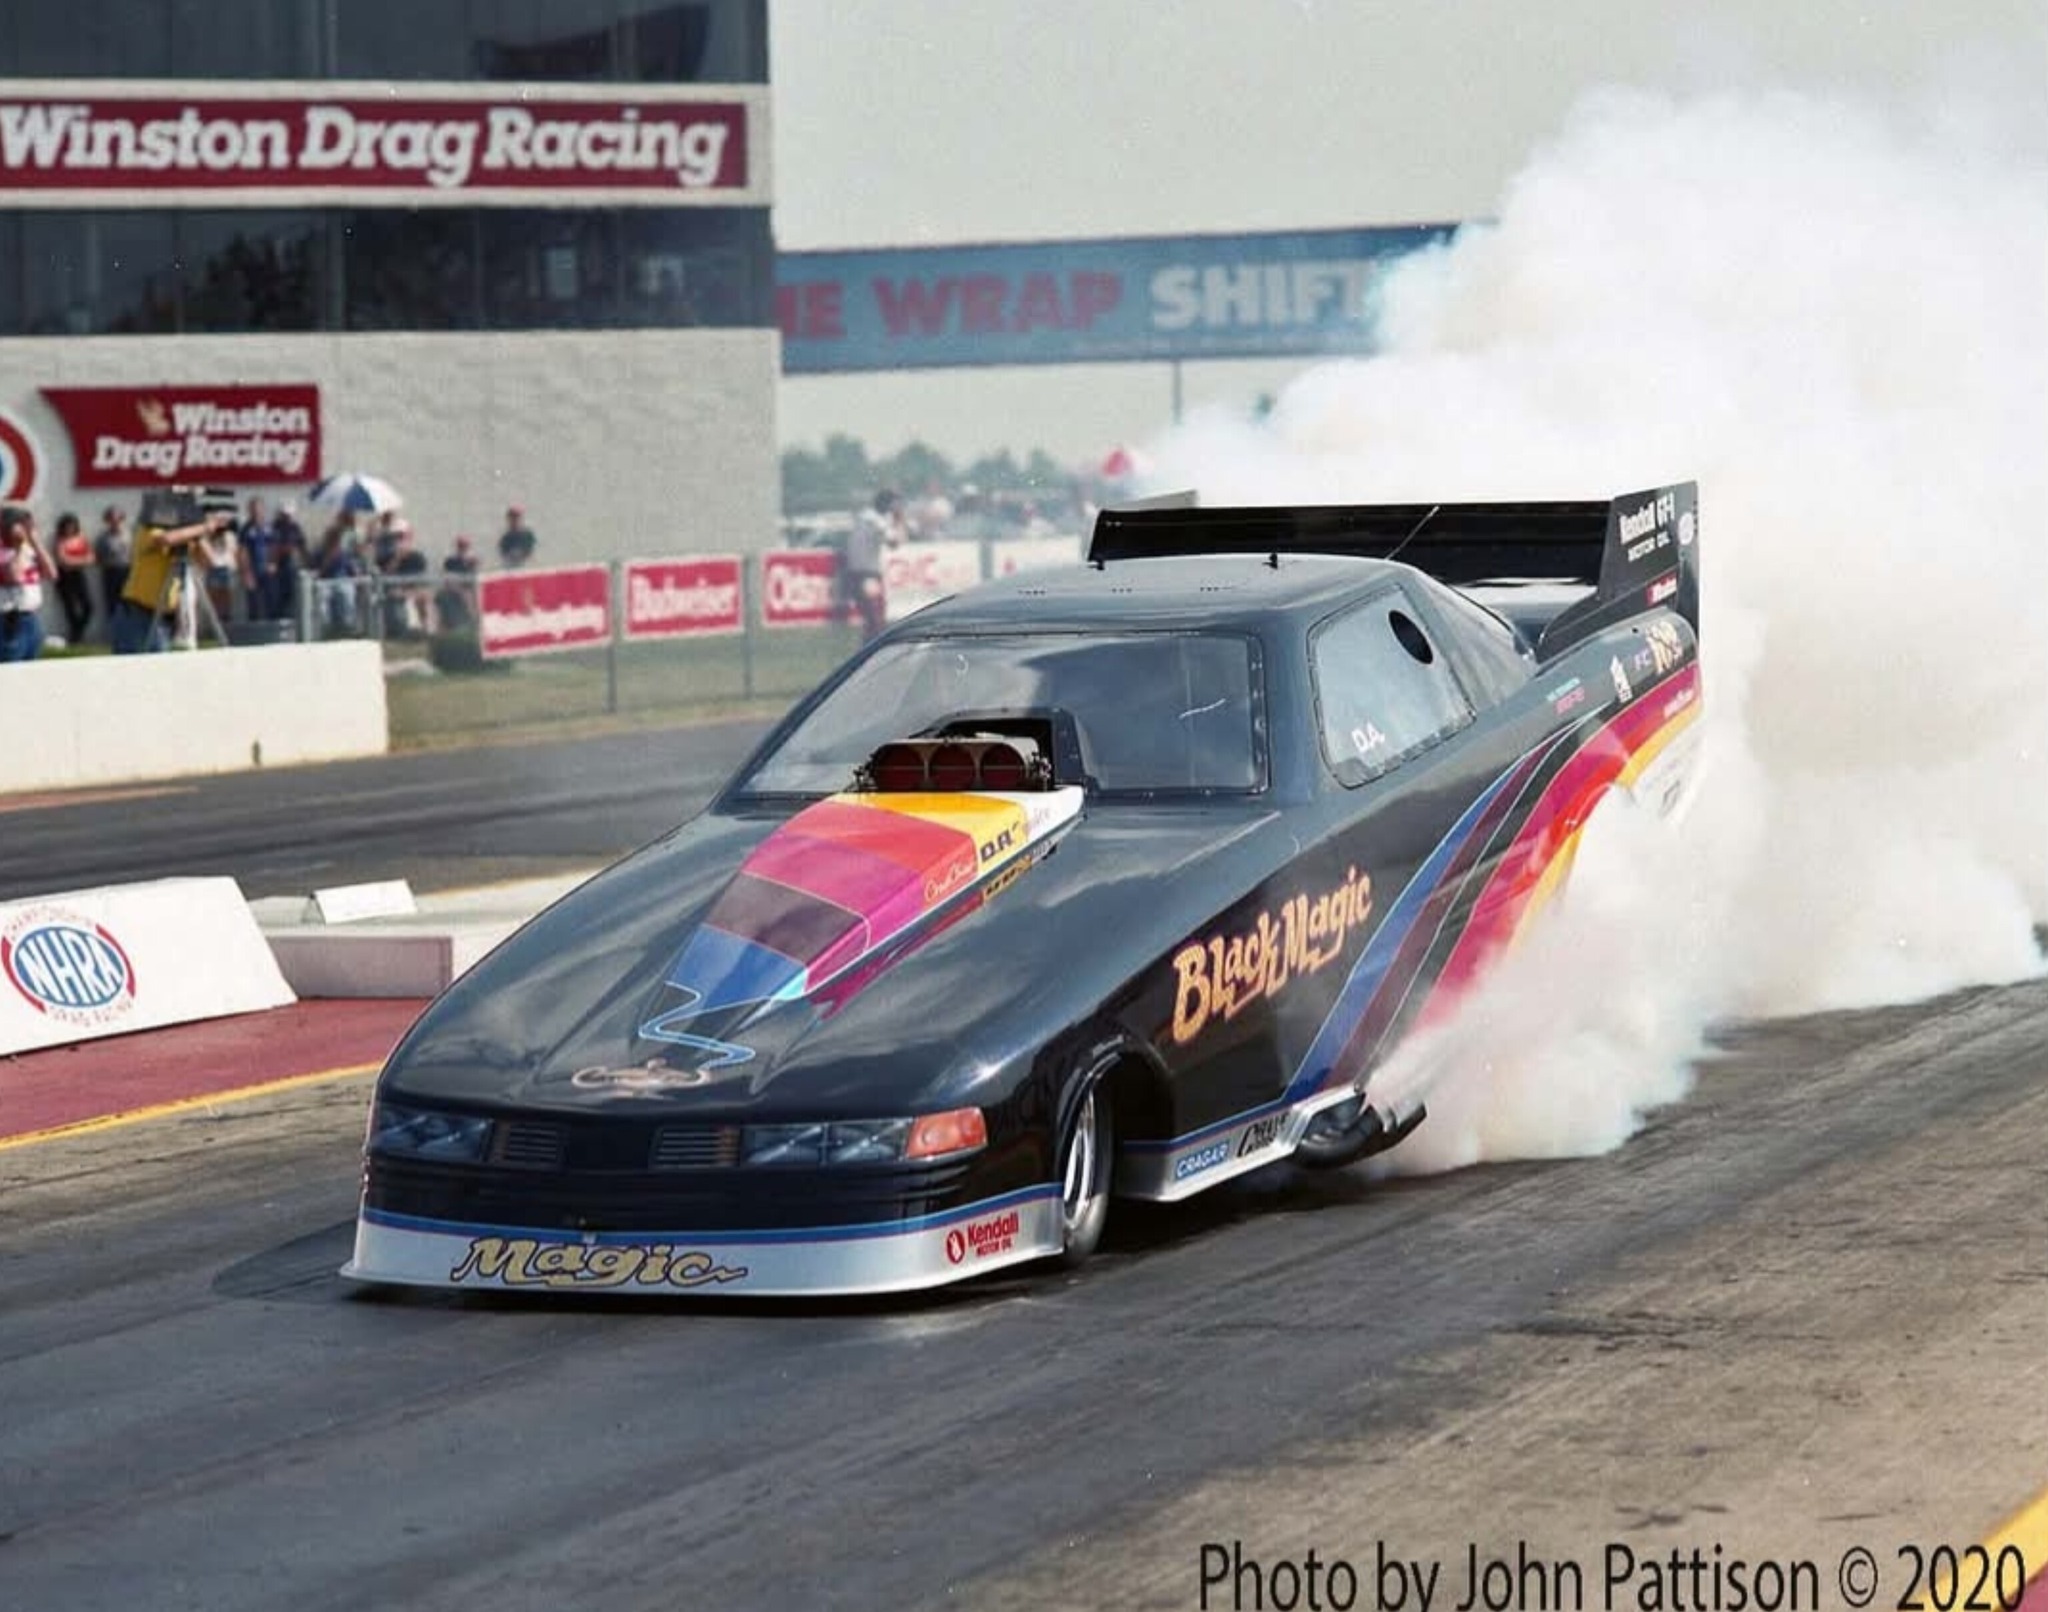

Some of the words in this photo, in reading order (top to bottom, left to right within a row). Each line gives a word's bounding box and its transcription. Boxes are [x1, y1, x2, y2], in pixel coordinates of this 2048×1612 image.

[0, 105, 289, 168] Winston
[299, 107, 478, 187] Drag
[482, 108, 728, 187] Racing
[872, 268, 1121, 334] WRAP
[172, 403, 311, 435] Winston
[93, 437, 182, 477] Drag
[184, 435, 308, 475] Racing
[18, 928, 124, 1004] NHRA
[1172, 911, 1288, 1043] Black
[1281, 865, 1373, 977] Magic
[966, 1211, 1019, 1248] Kendall
[450, 1237, 748, 1288] Magic
